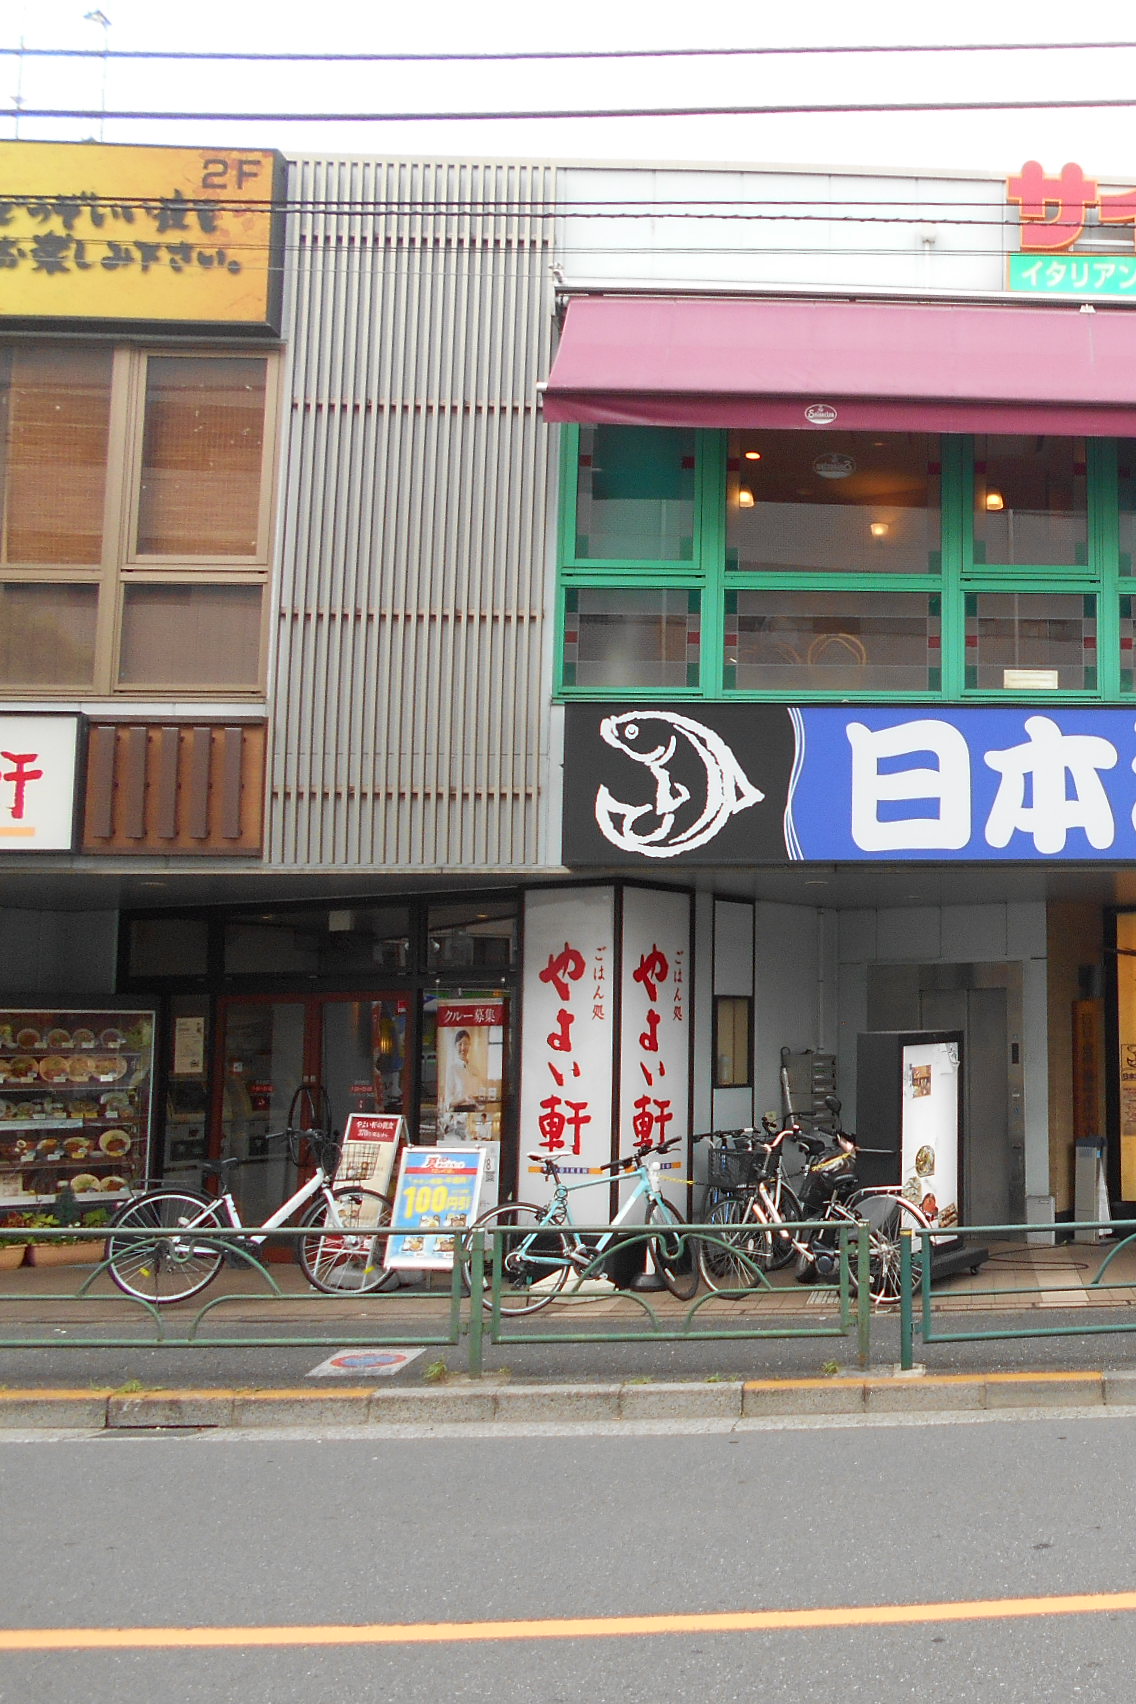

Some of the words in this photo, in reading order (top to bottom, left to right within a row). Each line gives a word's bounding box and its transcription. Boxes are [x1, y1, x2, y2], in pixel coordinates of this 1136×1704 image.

[202, 158, 261, 189] 2F
[444, 1008, 496, 1024] クルー募集
[592, 945, 608, 1021] ごはん処
[672, 950, 684, 1021] ごはん処
[538, 941, 592, 1155] やよい軒
[632, 942, 674, 1149] やよい軒
